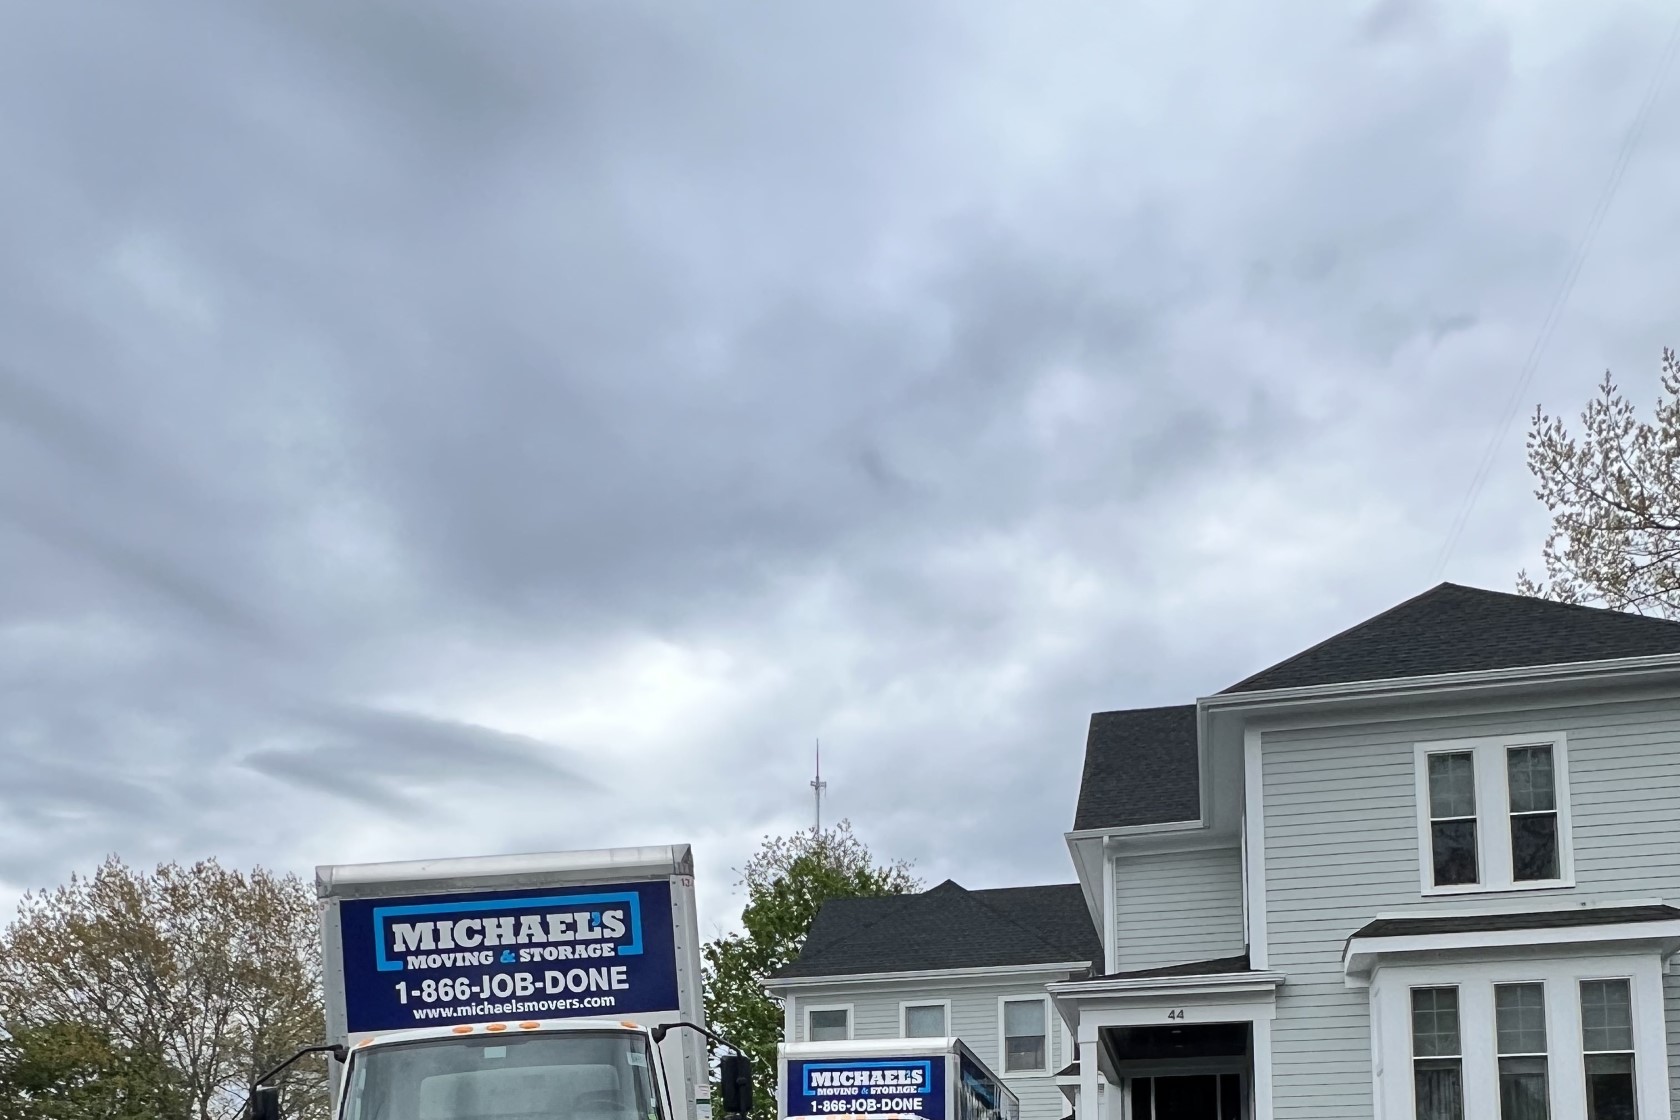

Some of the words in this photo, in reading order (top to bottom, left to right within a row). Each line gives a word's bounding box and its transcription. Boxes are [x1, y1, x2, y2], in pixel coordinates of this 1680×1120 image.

[392, 910, 626, 953] MICHAEL'S
[407, 951, 494, 970] MOVING
[500, 950, 516, 964] &
[519, 943, 615, 962] STORAGE
[395, 966, 630, 1004] 1-866-JOB-DONE
[413, 995, 616, 1020] www.michaelsmovers.com
[1168, 1009, 1184, 1020] 44
[817, 1087, 859, 1096] MOVING
[861, 1087, 869, 1095] &
[870, 1086, 917, 1094] STORAGE
[811, 1098, 923, 1112] 1-866-JOB-DONE
